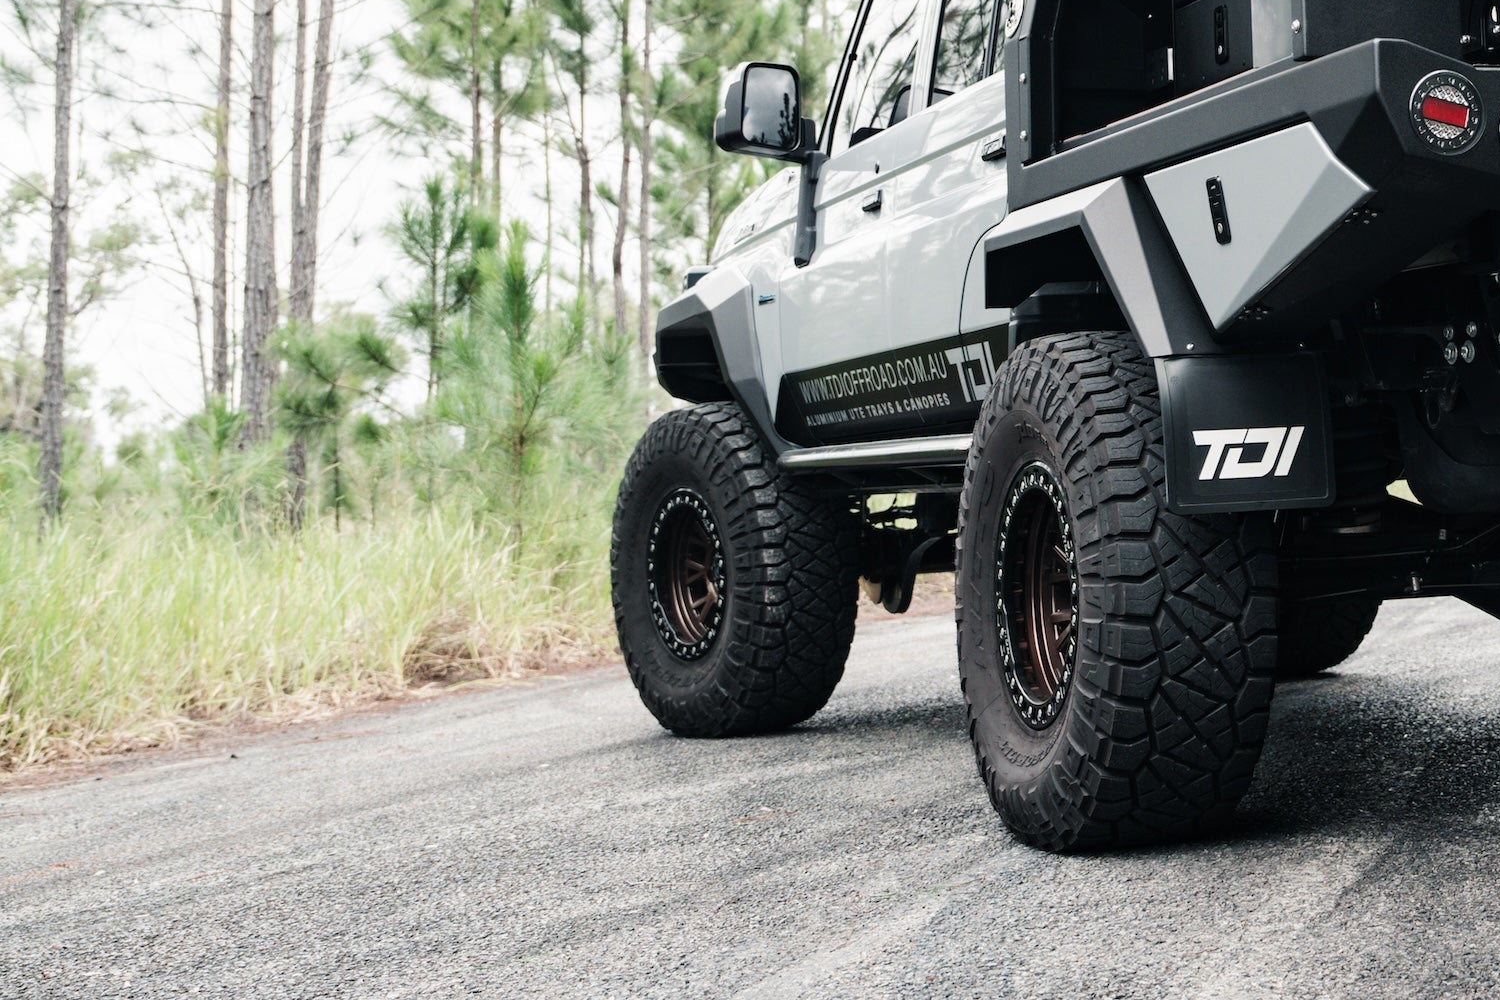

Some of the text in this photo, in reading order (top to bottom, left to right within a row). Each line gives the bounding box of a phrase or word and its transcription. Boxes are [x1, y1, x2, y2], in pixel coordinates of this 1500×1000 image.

[799, 351, 948, 404] WWW.TDIOFFROAD.COM.AU
[806, 392, 951, 427] ALUMINIUM UTE TRAYS & CANOPIES
[1192, 426, 1306, 481] TDI
